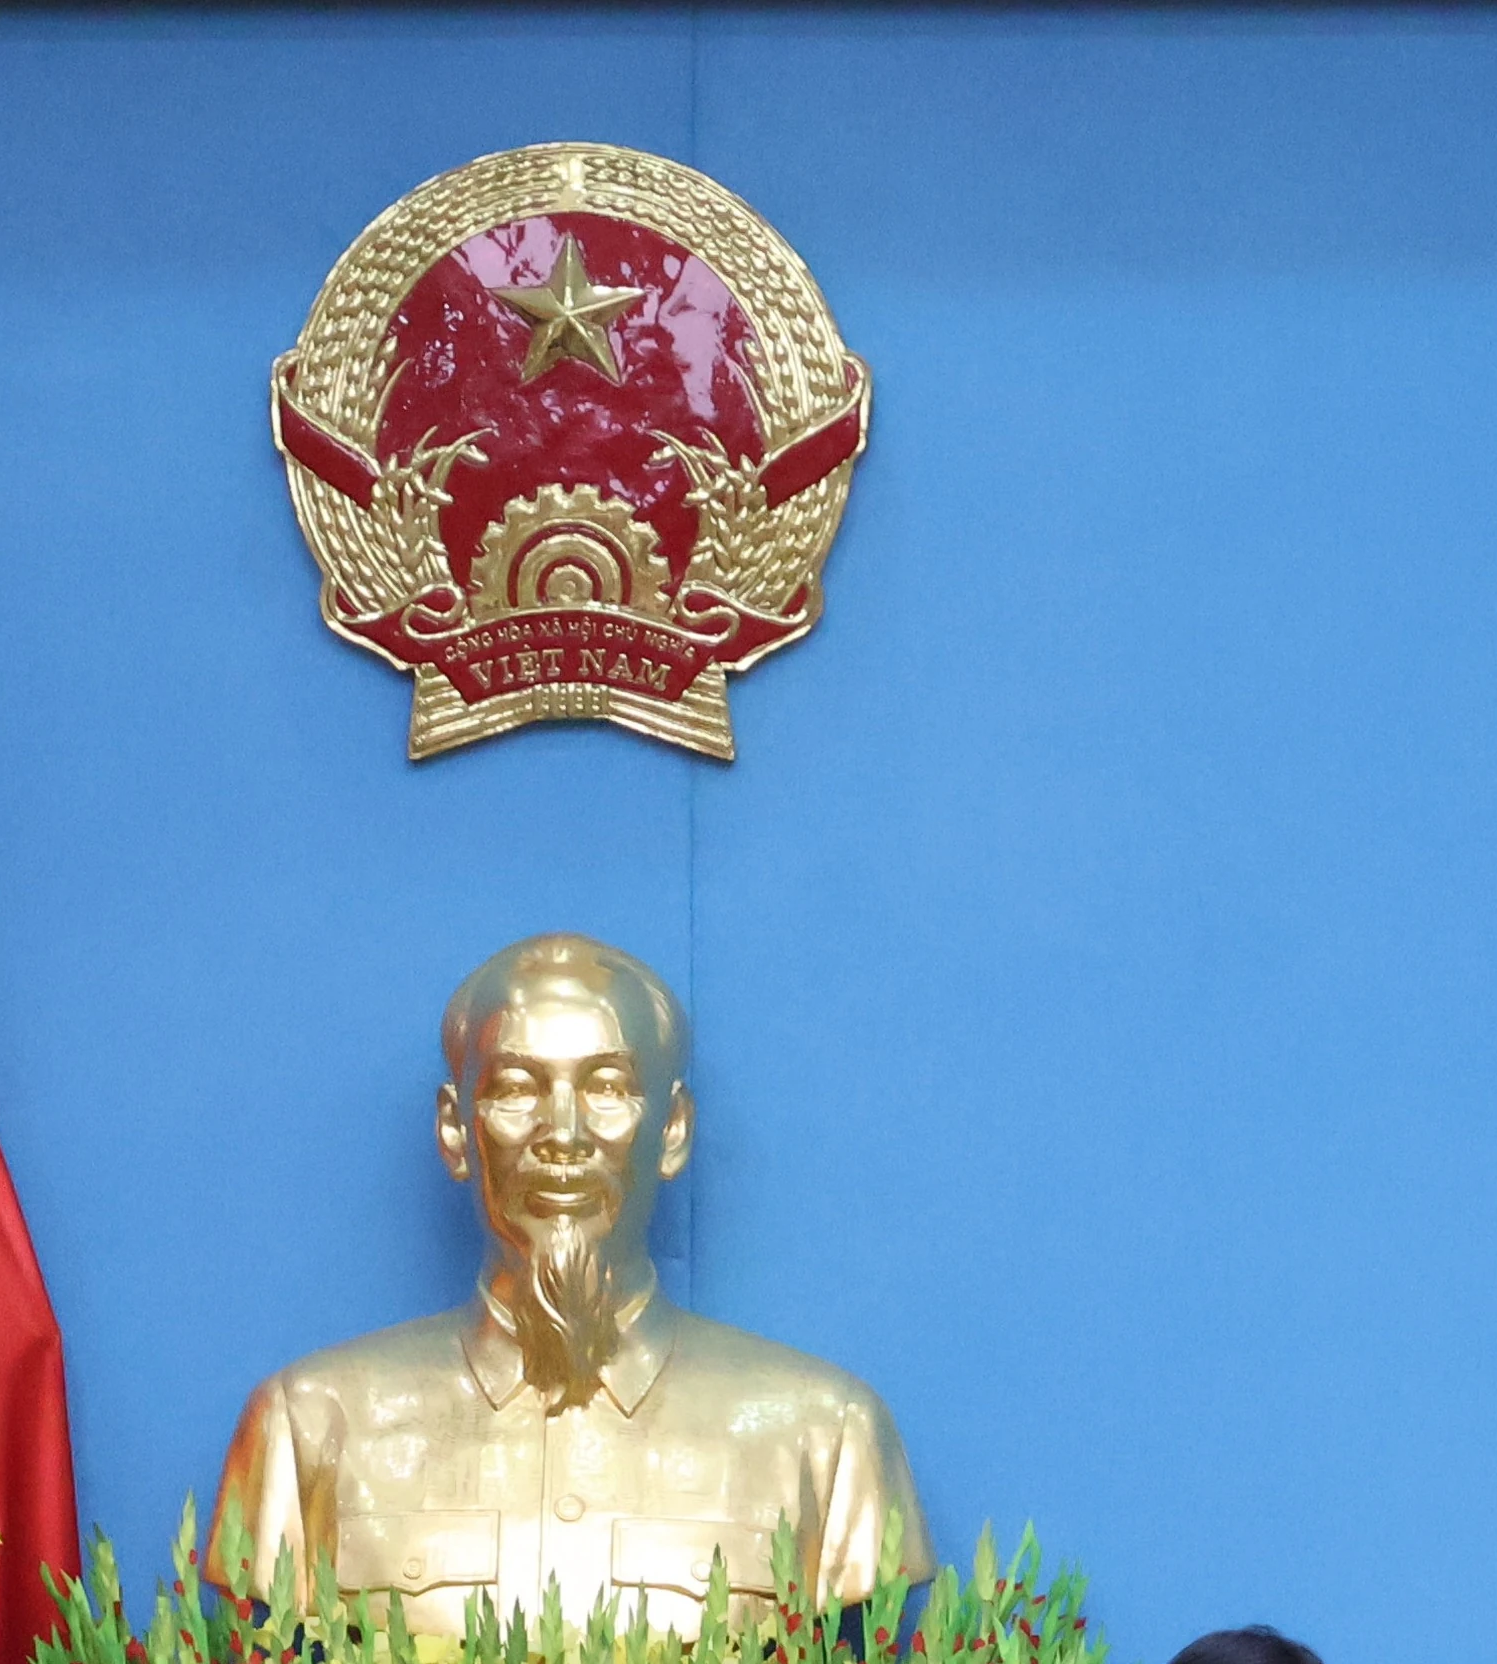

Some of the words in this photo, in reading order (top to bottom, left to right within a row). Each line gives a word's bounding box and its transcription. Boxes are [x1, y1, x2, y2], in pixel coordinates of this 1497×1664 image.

[444, 634, 493, 663] CỘNG
[497, 621, 532, 643] HÒA
[539, 617, 563, 637] XÃ
[568, 616, 596, 642] HỘI
[469, 645, 565, 690] VIỆT
[578, 649, 671, 691] NAM
